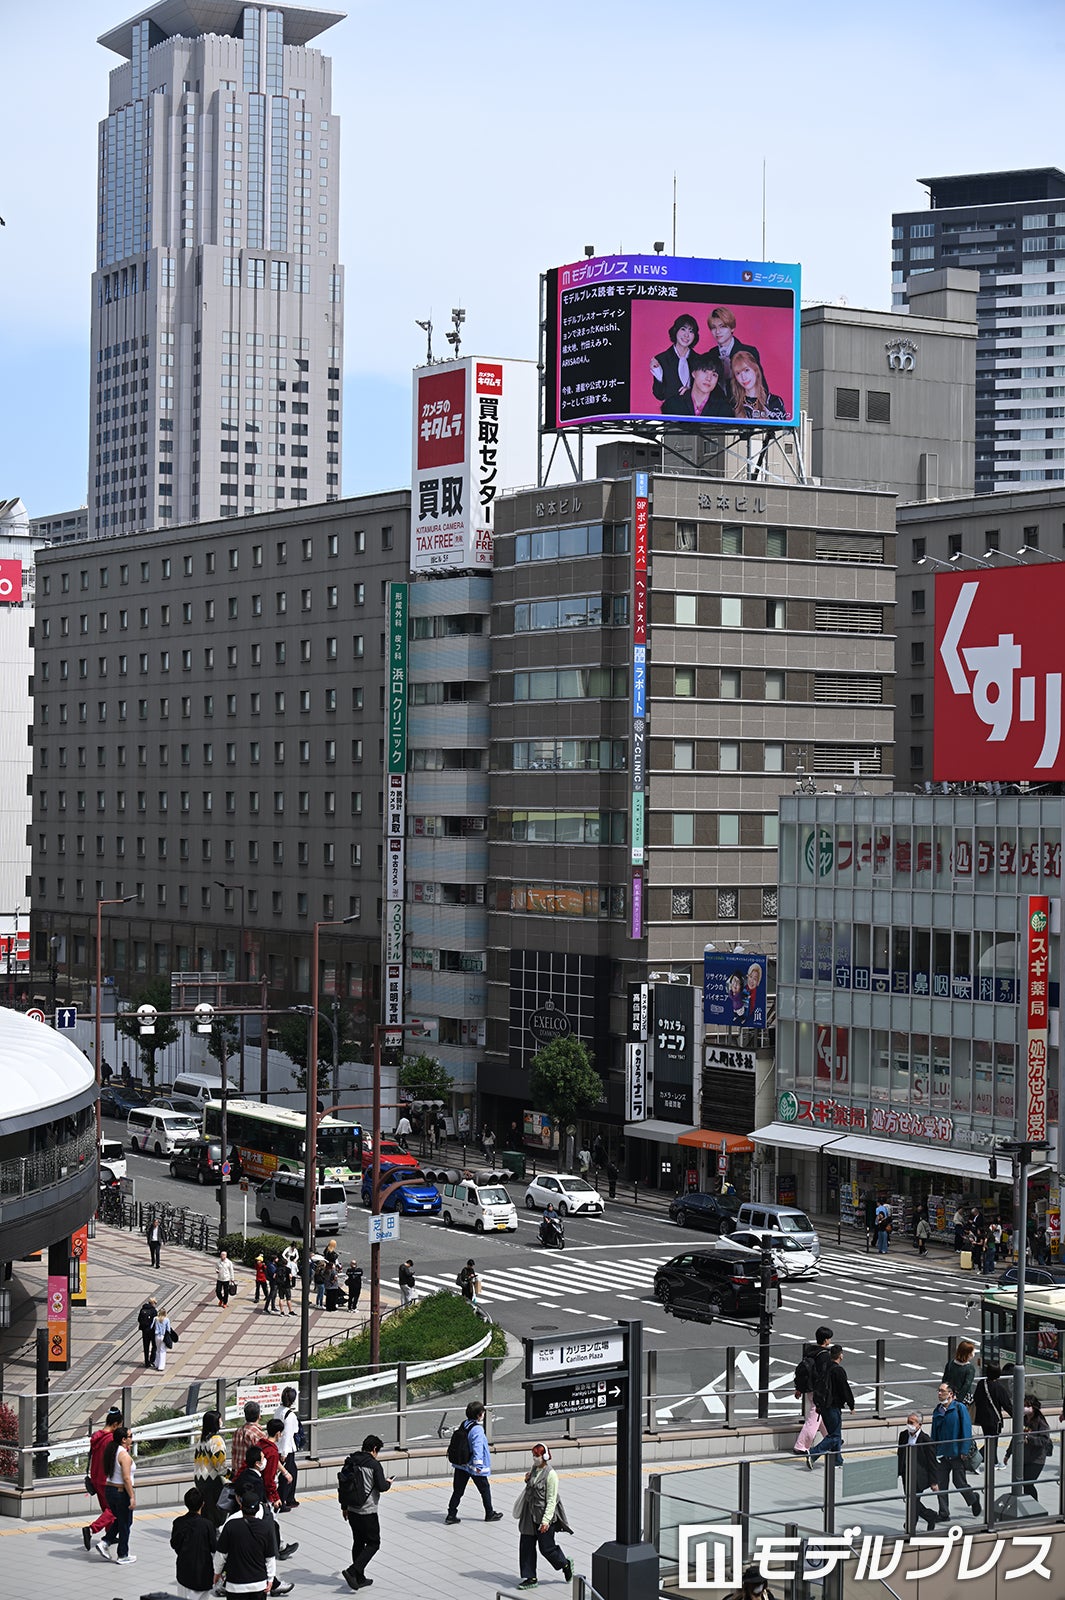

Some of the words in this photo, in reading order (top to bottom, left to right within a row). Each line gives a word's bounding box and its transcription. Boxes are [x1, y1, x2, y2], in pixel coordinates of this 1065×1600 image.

[572, 261, 628, 282] モデルプレス
[634, 264, 668, 276] NEWS
[753, 273, 792, 284] ミーグラム
[563, 284, 678, 305] モデルプレス読者モデルが決定
[478, 377, 501, 387] キタムラ
[422, 400, 450, 417] カメラの
[421, 412, 463, 442] キタムラ
[478, 397, 499, 524] 買取センター
[418, 476, 463, 521] 買取
[535, 497, 582, 517] 松本ビル
[698, 493, 767, 513] 松本ビル
[416, 524, 441, 534] KITAMURA
[443, 521, 464, 531] CAMERA
[637, 512, 646, 563] ボディスパ
[416, 535, 433, 551] TAX
[434, 533, 453, 549] FREE
[636, 580, 645, 634] ヘッドスパ
[940, 581, 1062, 769] くすり
[635, 667, 644, 714] ラポート
[392, 667, 404, 764] 浜口クリニック
[634, 733, 644, 783] Z-CLINIC
[391, 813, 401, 833] 買取
[705, 973, 728, 981] リサイクル
[836, 966, 869, 989] 守田
[894, 971, 993, 1000] 耳鼻咽喉科
[1030, 937, 1047, 1017] スギ薬局
[389, 982, 398, 1024] 証明写真
[632, 993, 640, 1031] 高価買取
[533, 1015, 567, 1031] EXELCO
[658, 1033, 685, 1051] ナニワ
[798, 1099, 867, 1129] スギ薬局
[871, 1108, 953, 1141] 処方せん受付
[373, 1216, 395, 1231] 芝田
[539, 1348, 554, 1356] ここは
[566, 1341, 609, 1355] カリヨン広場
[566, 1355, 588, 1364] Carillon
[589, 1352, 604, 1360] Plaza
